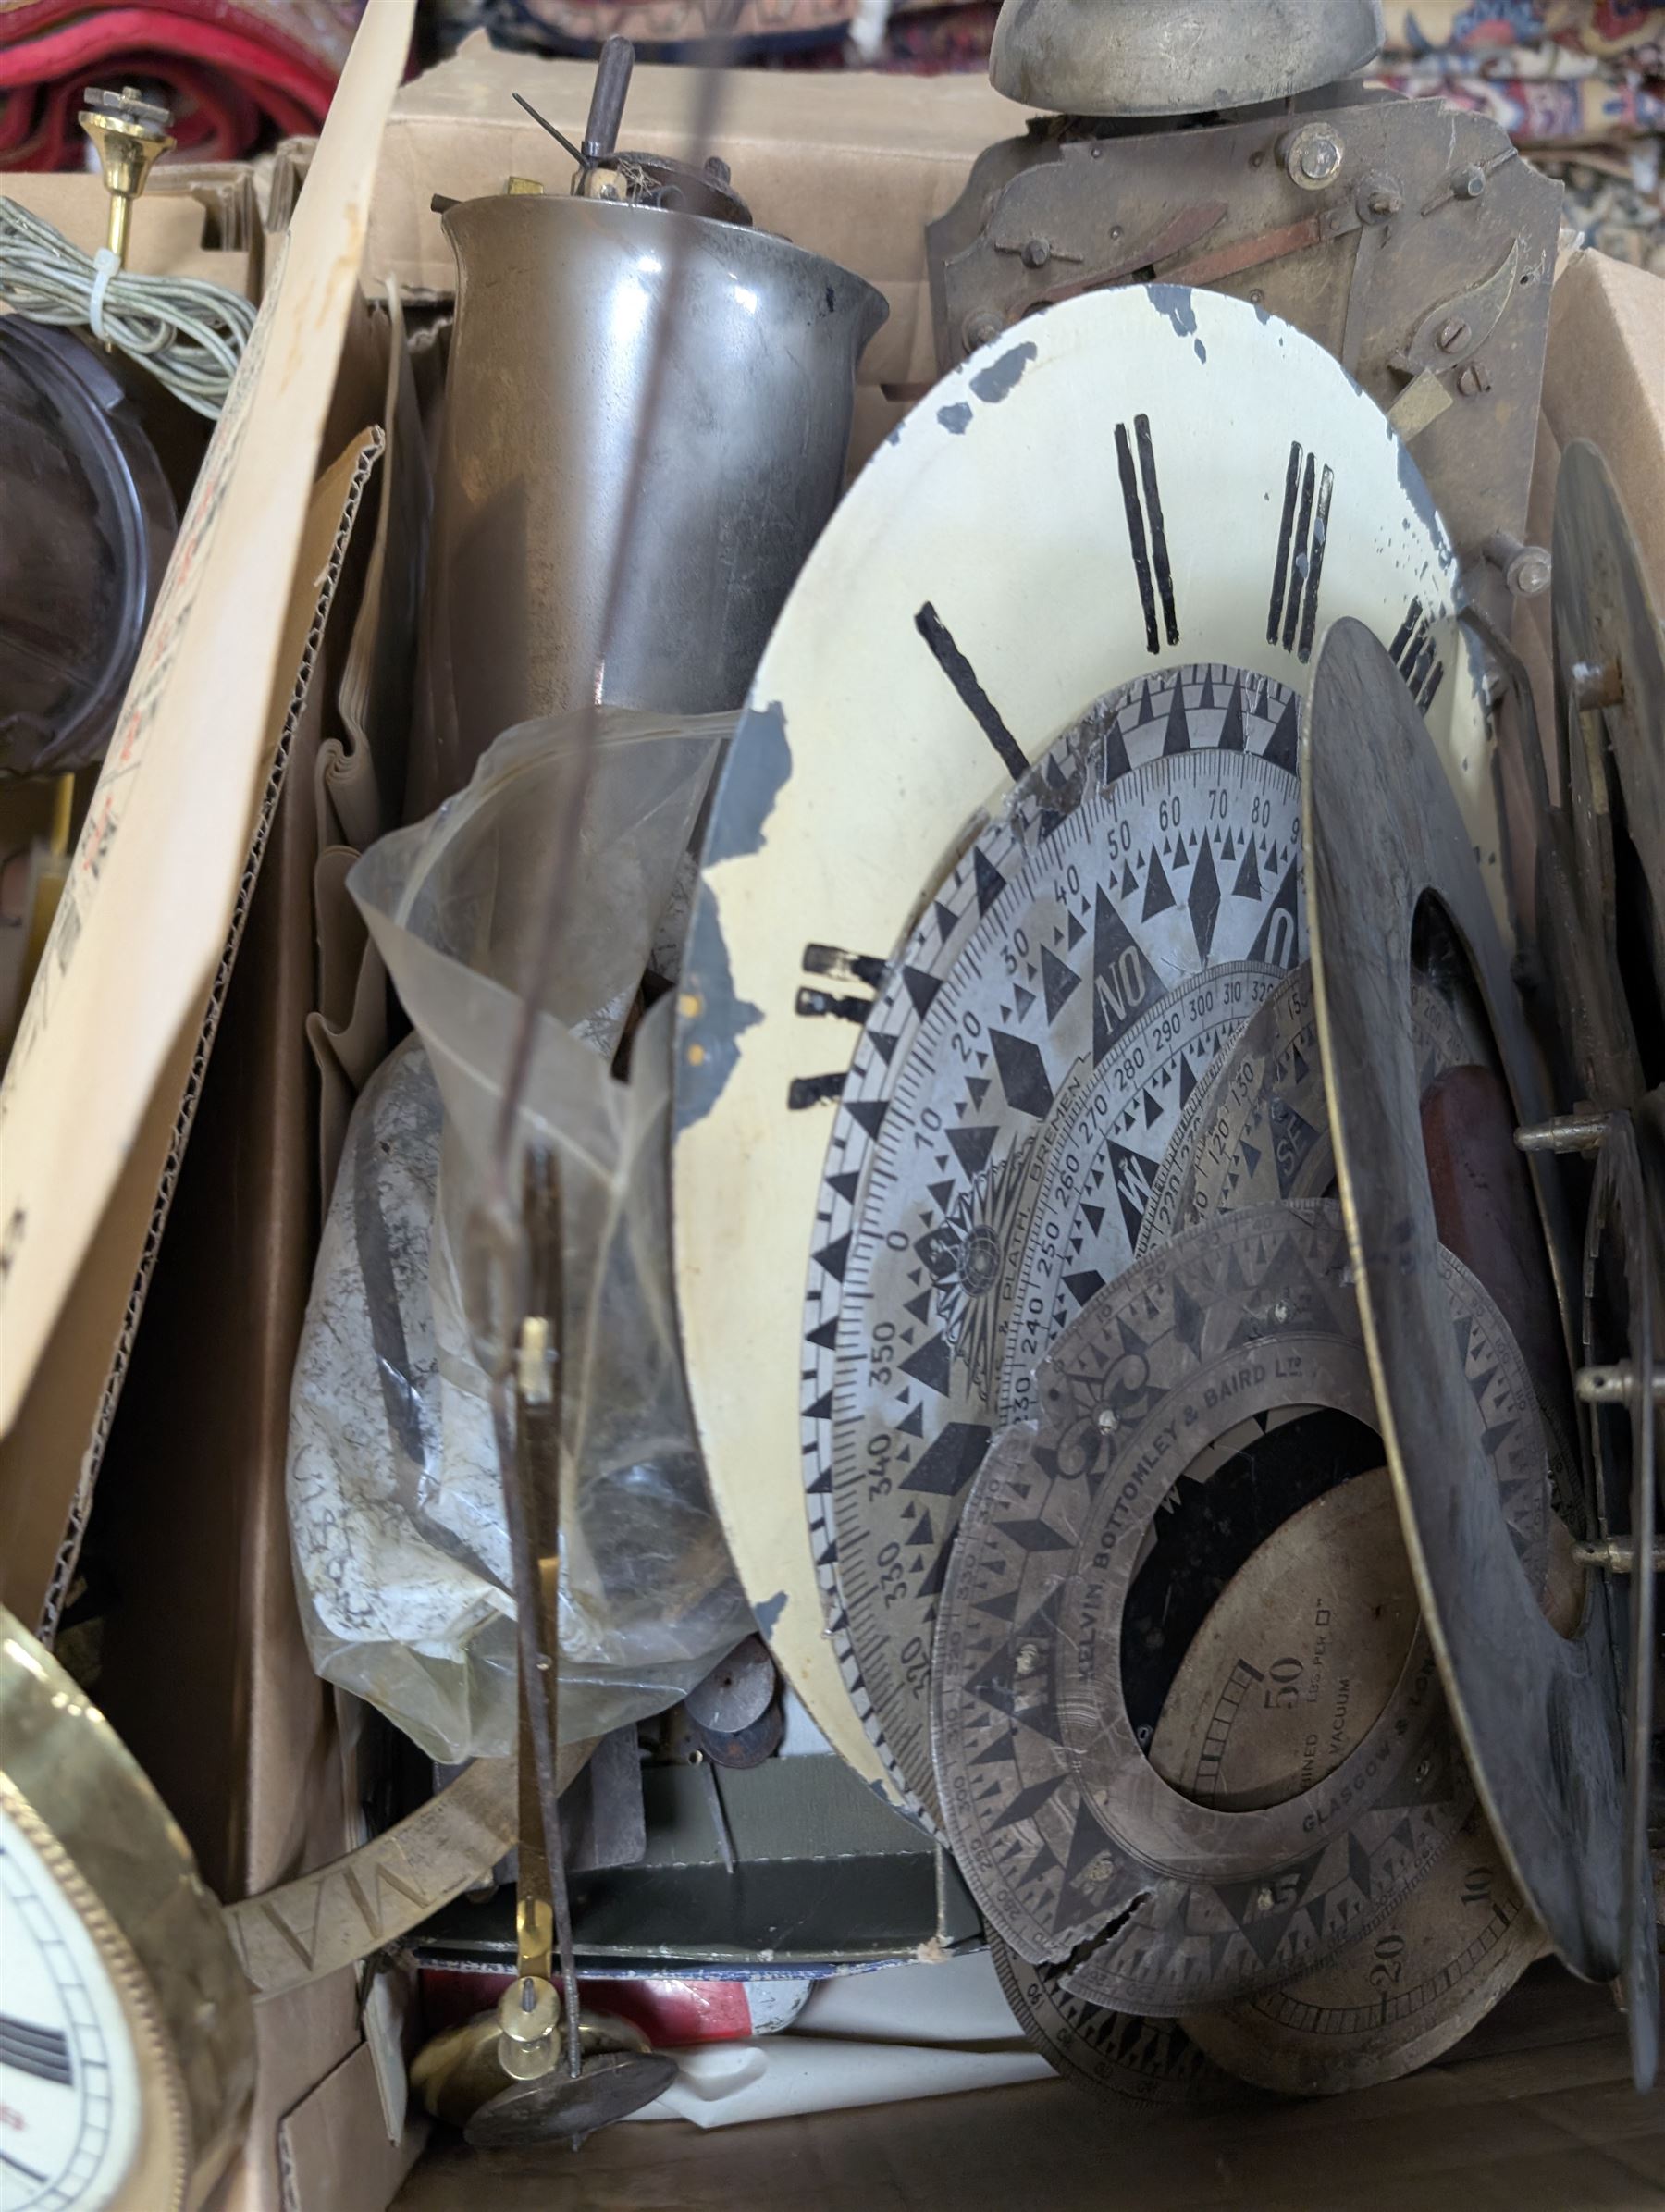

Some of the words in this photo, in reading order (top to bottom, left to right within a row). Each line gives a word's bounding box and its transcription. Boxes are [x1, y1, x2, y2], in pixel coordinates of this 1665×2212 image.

[1158, 795, 1182, 832] 60
[1208, 788, 1228, 821] 70
[1251, 796, 1271, 828] 80
[1106, 819, 1132, 861] 50
[1290, 817, 1305, 851] 9
[1053, 863, 1080, 907] 40
[999, 927, 1030, 977] 30
[1093, 945, 1147, 1033] NO
[1187, 990, 1215, 1023] 300
[1222, 980, 1243, 1006] 310
[951, 1009, 982, 1064] 20
[1153, 1011, 1182, 1051] 290
[1113, 1046, 1146, 1092] 280
[1230, 1060, 1255, 1107] 130
[913, 1106, 943, 1150] 10
[1029, 1076, 1084, 1183] BREMEN
[1078, 1094, 1109, 1145] 270
[1207, 1117, 1230, 1166] 120
[1276, 1116, 1309, 1179] SE
[1054, 1153, 1081, 1209] 260
[1117, 1155, 1154, 1215] W
[885, 1230, 911, 1254] 0
[1036, 1221, 1062, 1279] 250
[1020, 1296, 1045, 1356] 240
[1097, 1304, 1112, 1324] 10
[868, 1320, 897, 1388] 350
[867, 1432, 893, 1503] 340
[1092, 1417, 1178, 1571] BOTTOMLEY
[1183, 1405, 1199, 1427] &
[1203, 1365, 1266, 1410] BAIRD
[875, 1540, 908, 1611] 330
[899, 1636, 934, 1700] 320
[1313, 1636, 1327, 1665] PER
[1264, 1656, 1305, 1711] 50
[1306, 1671, 1322, 1704] LBS
[1328, 1677, 1351, 1756] VACUUM
[952, 1775, 970, 1814] 300
[1302, 1745, 1391, 1834] GLASGOW
[970, 1837, 993, 1873] 290
[996, 1888, 1021, 1921] 280
[1460, 1866, 1494, 1908] 10
[1368, 1934, 1407, 1987] 20
[1027, 1983, 1045, 2010] 190
